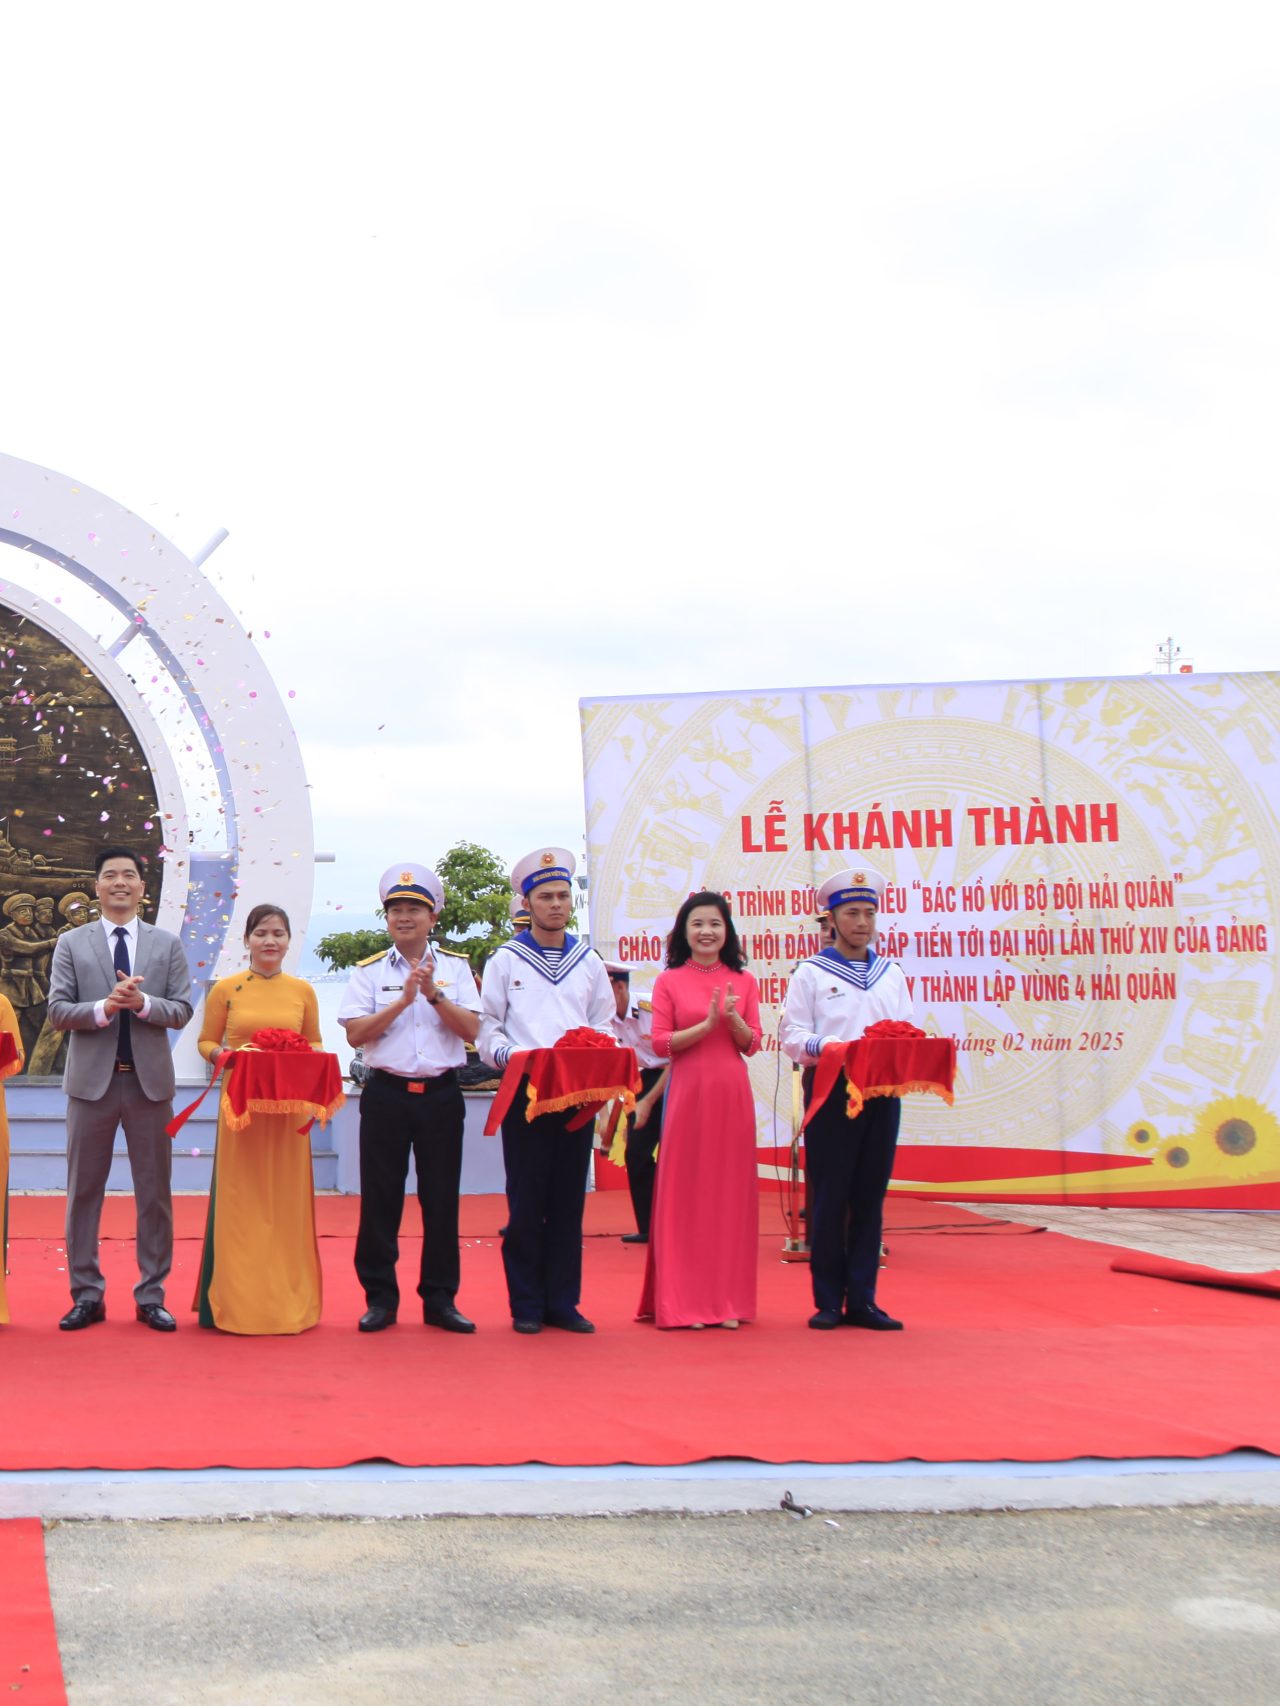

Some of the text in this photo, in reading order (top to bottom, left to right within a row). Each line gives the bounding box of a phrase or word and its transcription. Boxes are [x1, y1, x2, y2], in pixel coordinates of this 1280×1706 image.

[741, 797, 1119, 853] LỄ KHÁNH THÀNH
[737, 885, 786, 917] TRÌNH
[912, 880, 956, 914] “BÁC
[962, 876, 985, 913] HỒ
[990, 879, 1018, 912] VỚI
[1024, 877, 1048, 917] BỘ
[1053, 876, 1083, 916] ĐỘI
[1089, 873, 1118, 910] HẢI
[1124, 873, 1183, 912] QUÂN”
[619, 930, 662, 961] CHÀO
[752, 929, 780, 966] HỘI
[785, 925, 821, 960] ĐẢN
[914, 922, 952, 959] TIẾN
[957, 924, 984, 957] TỚI
[990, 930, 1019, 962] ĐẠI
[1024, 923, 1054, 962] HỘI
[1060, 919, 1095, 956] LẦN
[1100, 921, 1136, 955] THỨ
[1140, 927, 1168, 954] XIV
[1174, 917, 1212, 954] CỦA
[1216, 916, 1267, 953] ĐẢNG
[921, 970, 978, 1003] THÀNH
[983, 969, 1016, 1008] LẬP
[1022, 968, 1070, 1002] VÙNG
[1075, 973, 1086, 1001] 4
[1091, 964, 1120, 1001] HẢI
[1126, 967, 1176, 1004] QUÂN
[951, 1031, 1124, 1057] háng 02 năm 2025
